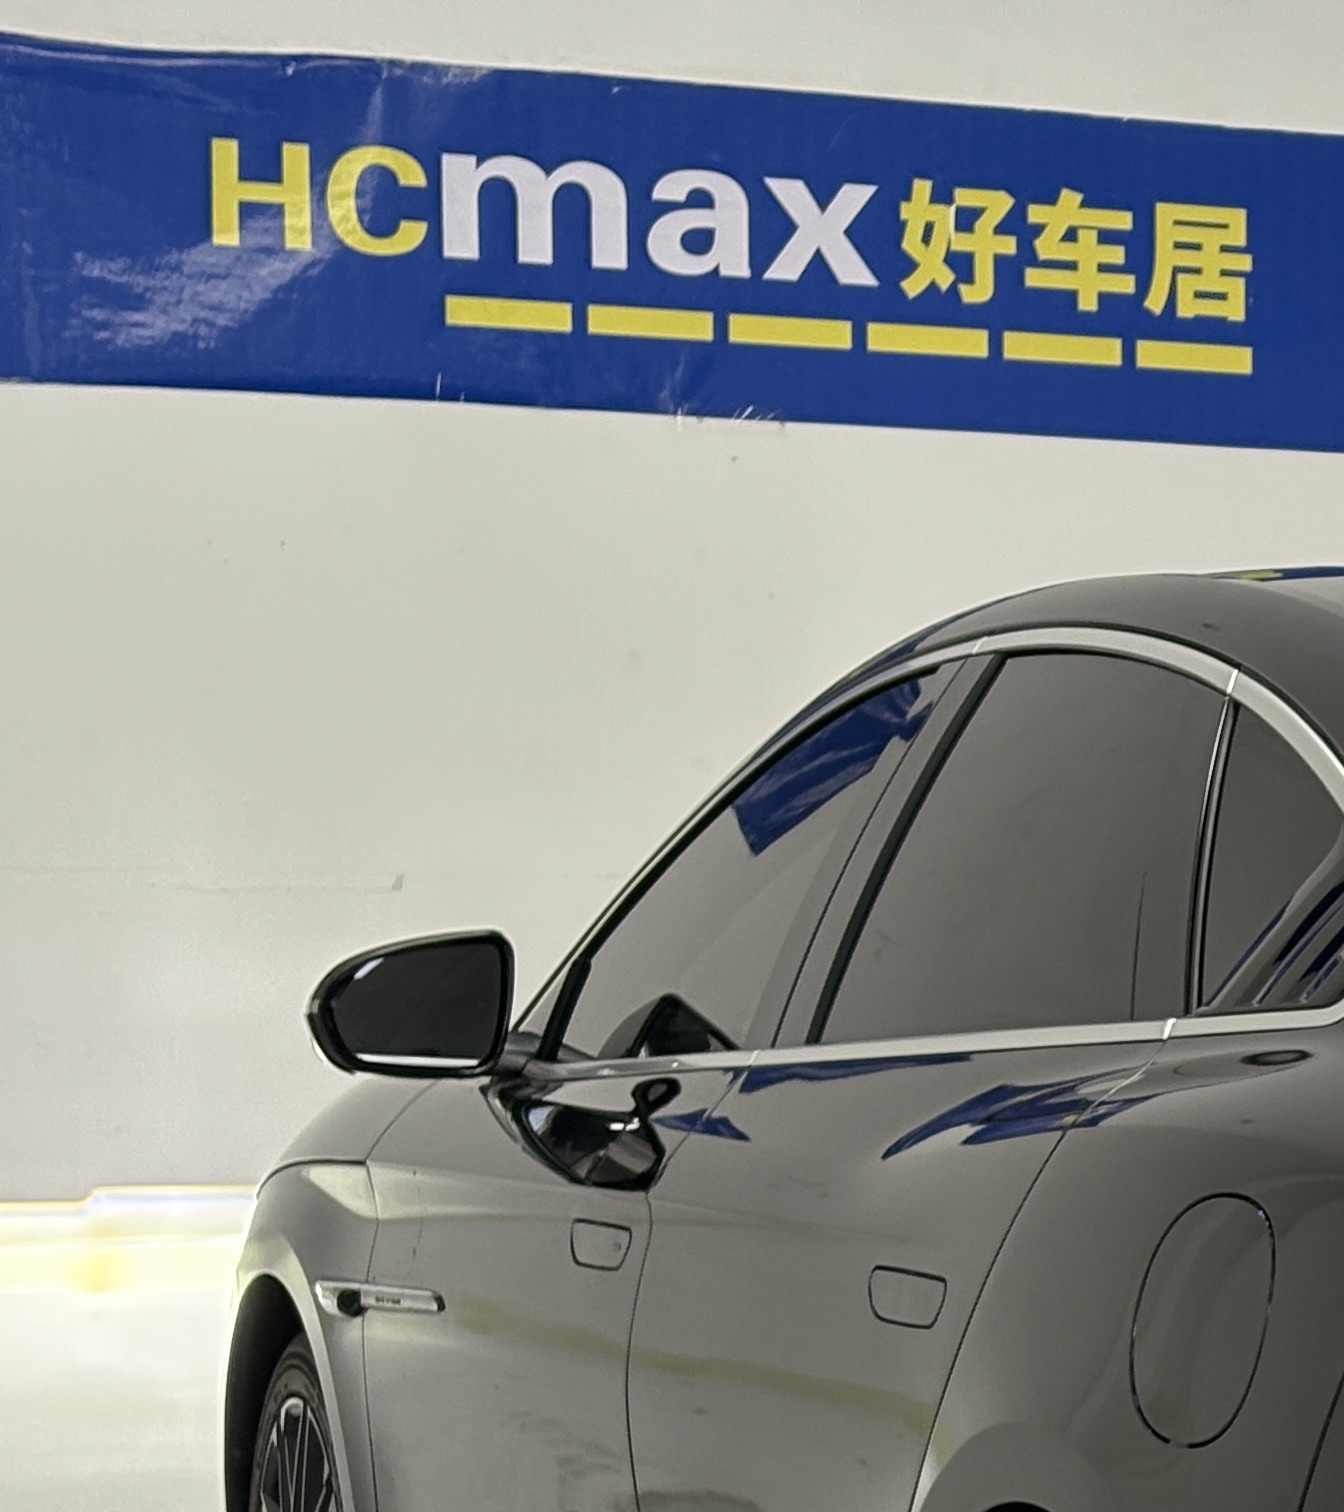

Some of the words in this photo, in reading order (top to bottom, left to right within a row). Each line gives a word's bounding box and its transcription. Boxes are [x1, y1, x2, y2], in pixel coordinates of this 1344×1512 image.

[209, 135, 879, 288] HCmax
[898, 177, 1253, 322] 好车居
